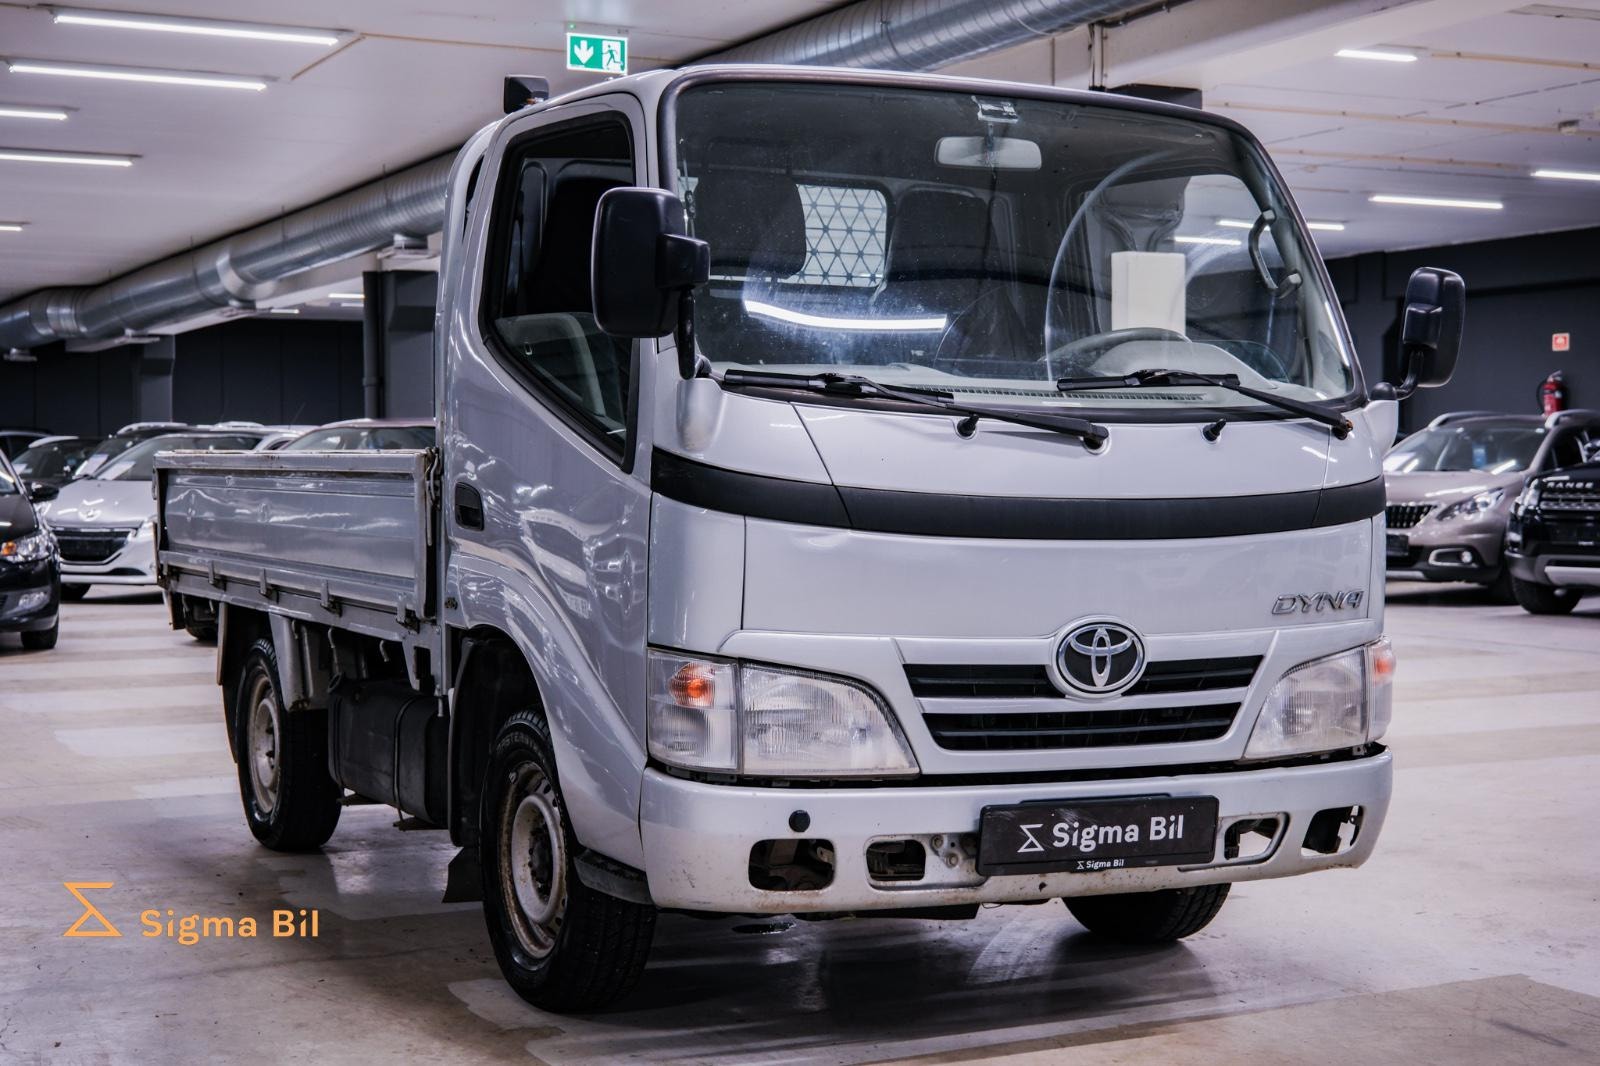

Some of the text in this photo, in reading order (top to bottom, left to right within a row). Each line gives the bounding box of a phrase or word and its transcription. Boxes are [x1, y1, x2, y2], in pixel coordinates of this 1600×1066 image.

[1547, 481, 1594, 489] RANGE
[1271, 590, 1365, 615] DYNA
[1052, 814, 1184, 852] Sigma Bil
[1086, 859, 1124, 869] Sigma Bil
